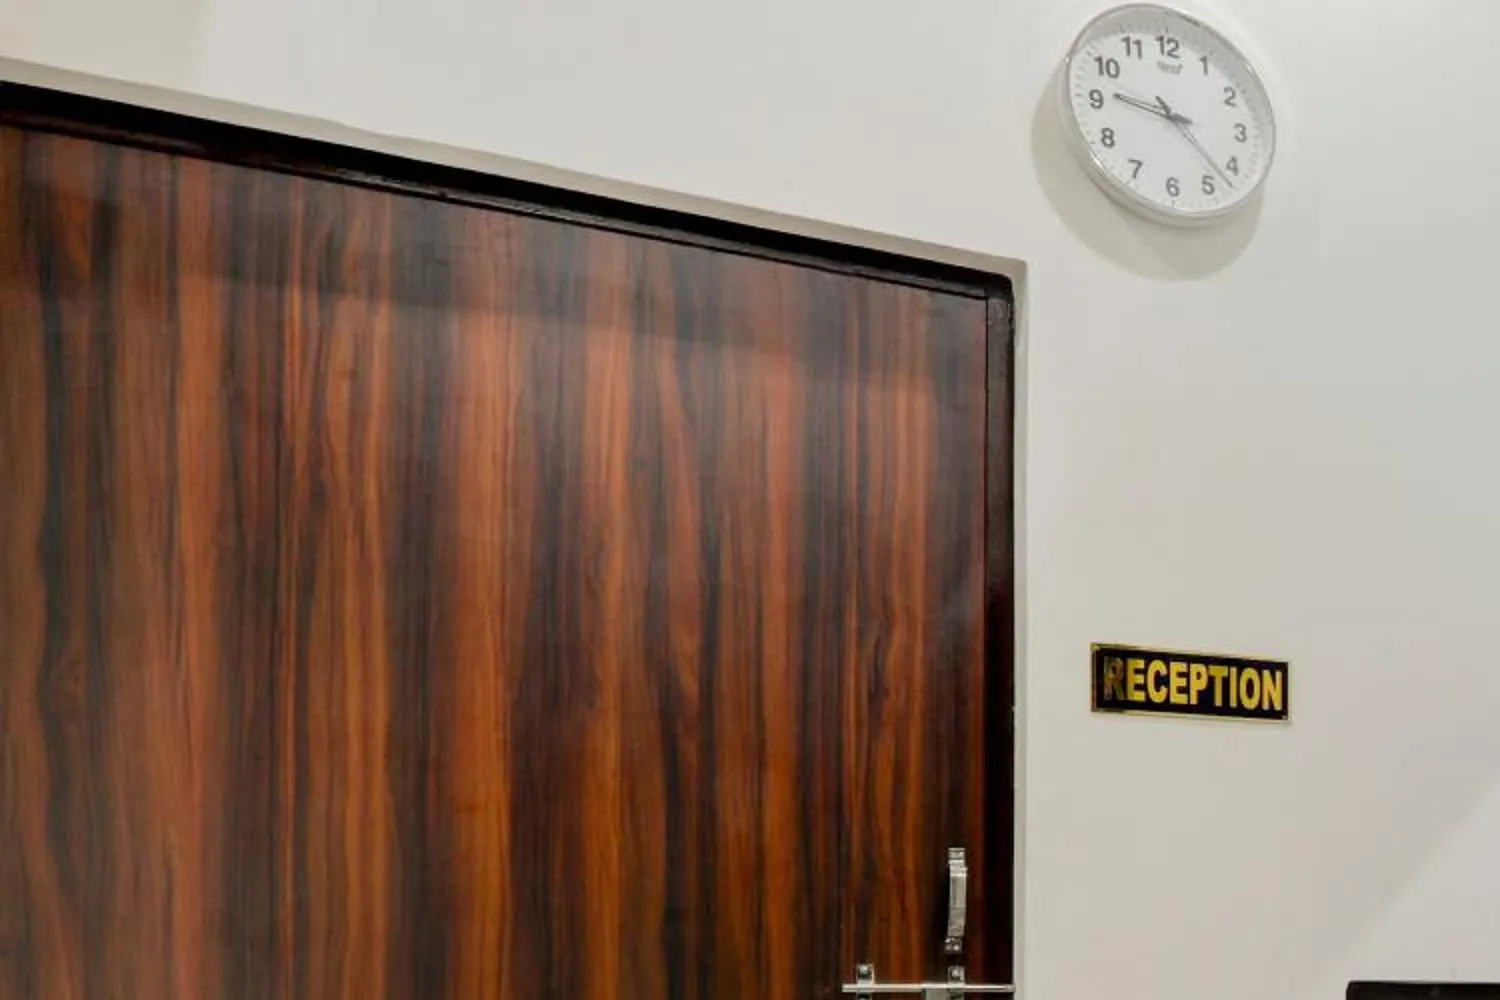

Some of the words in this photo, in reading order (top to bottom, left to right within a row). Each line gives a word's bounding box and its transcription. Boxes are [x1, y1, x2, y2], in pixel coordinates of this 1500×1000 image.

[1121, 36, 1143, 60] 11
[1155, 35, 1181, 59] 12
[1094, 56, 1121, 79] 10
[1199, 55, 1209, 76] 1
[1088, 88, 1104, 109] 9
[1223, 86, 1237, 107] 2
[1100, 127, 1115, 149] 8
[1234, 123, 1248, 143] 3
[1127, 159, 1143, 179] 7
[1225, 156, 1239, 176] 4
[1165, 177, 1180, 197] 6
[1201, 175, 1216, 196] 5
[1103, 655, 1283, 711] RECEPTION
